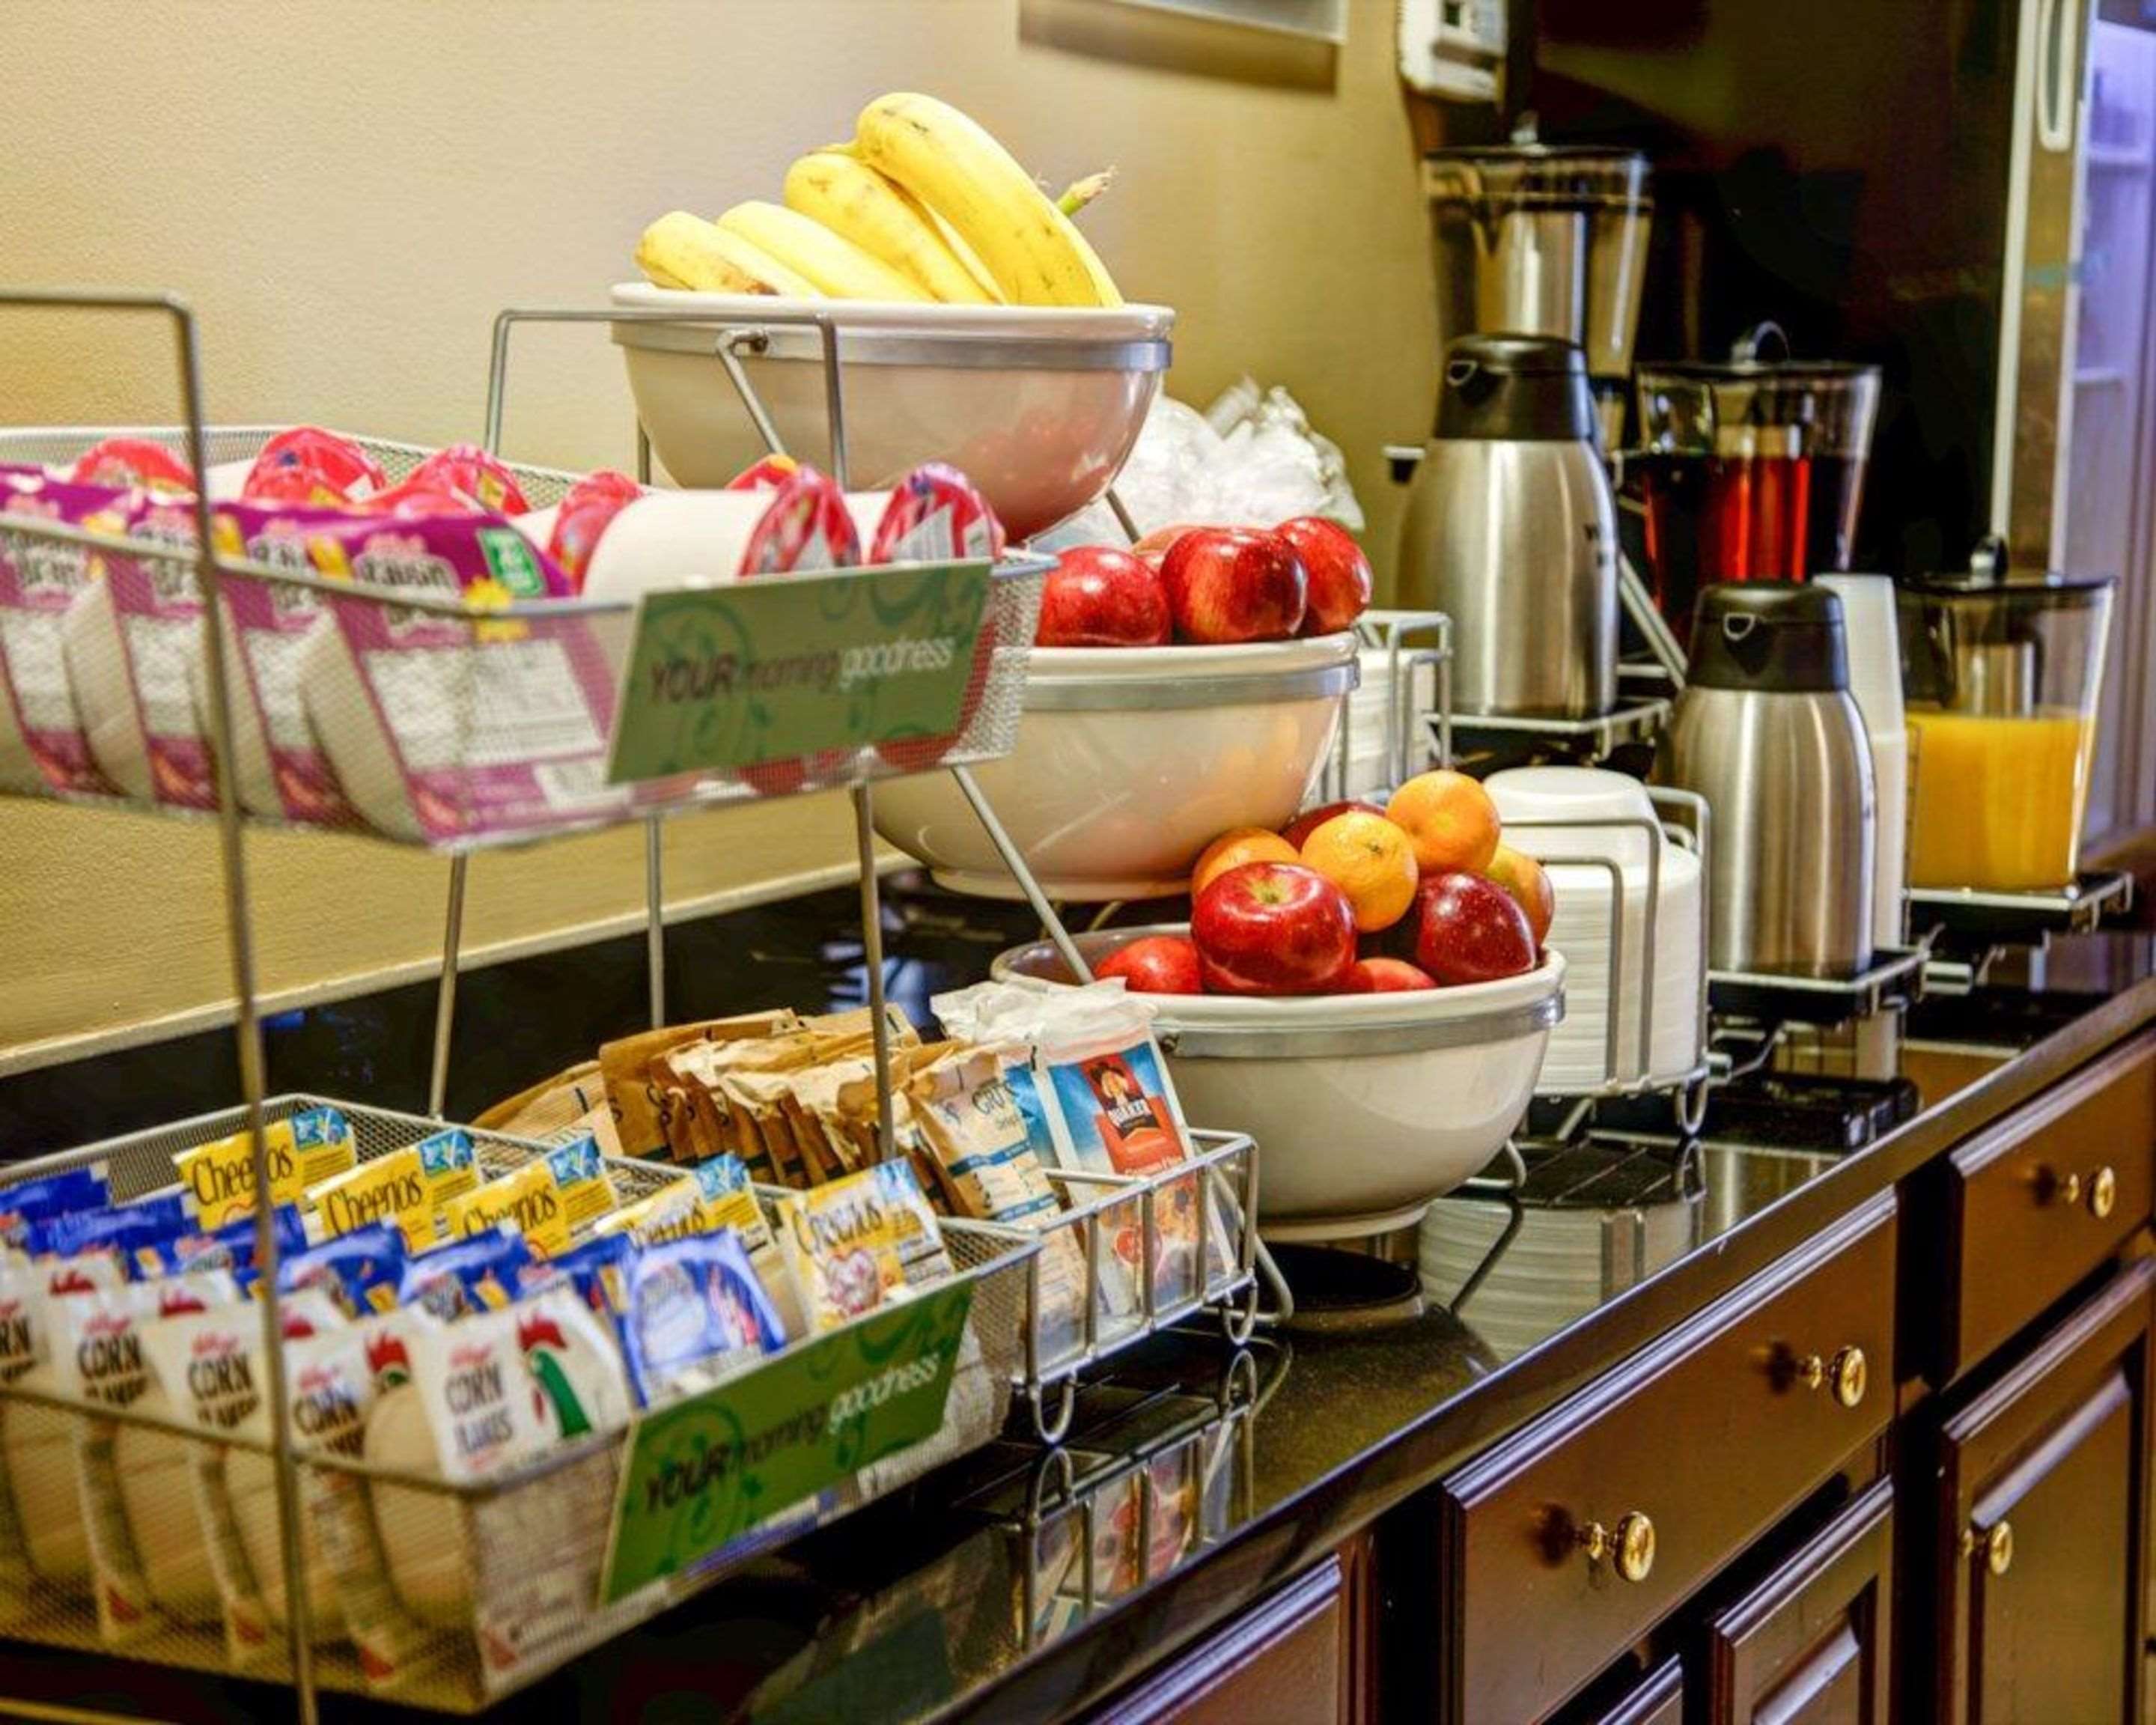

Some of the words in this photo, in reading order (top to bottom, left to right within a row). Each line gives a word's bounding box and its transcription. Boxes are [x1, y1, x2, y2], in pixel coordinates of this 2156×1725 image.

[650, 653, 736, 703] YOUR
[839, 636, 956, 693] goodness
[192, 1143, 293, 1206] Cheeos
[463, 1183, 557, 1235] Chrios
[77, 1328, 142, 1380] CORN
[188, 1350, 253, 1401] CORN
[444, 1361, 504, 1415] CORN
[646, 1441, 732, 1507] YOUR
[828, 1352, 942, 1435] goodness
